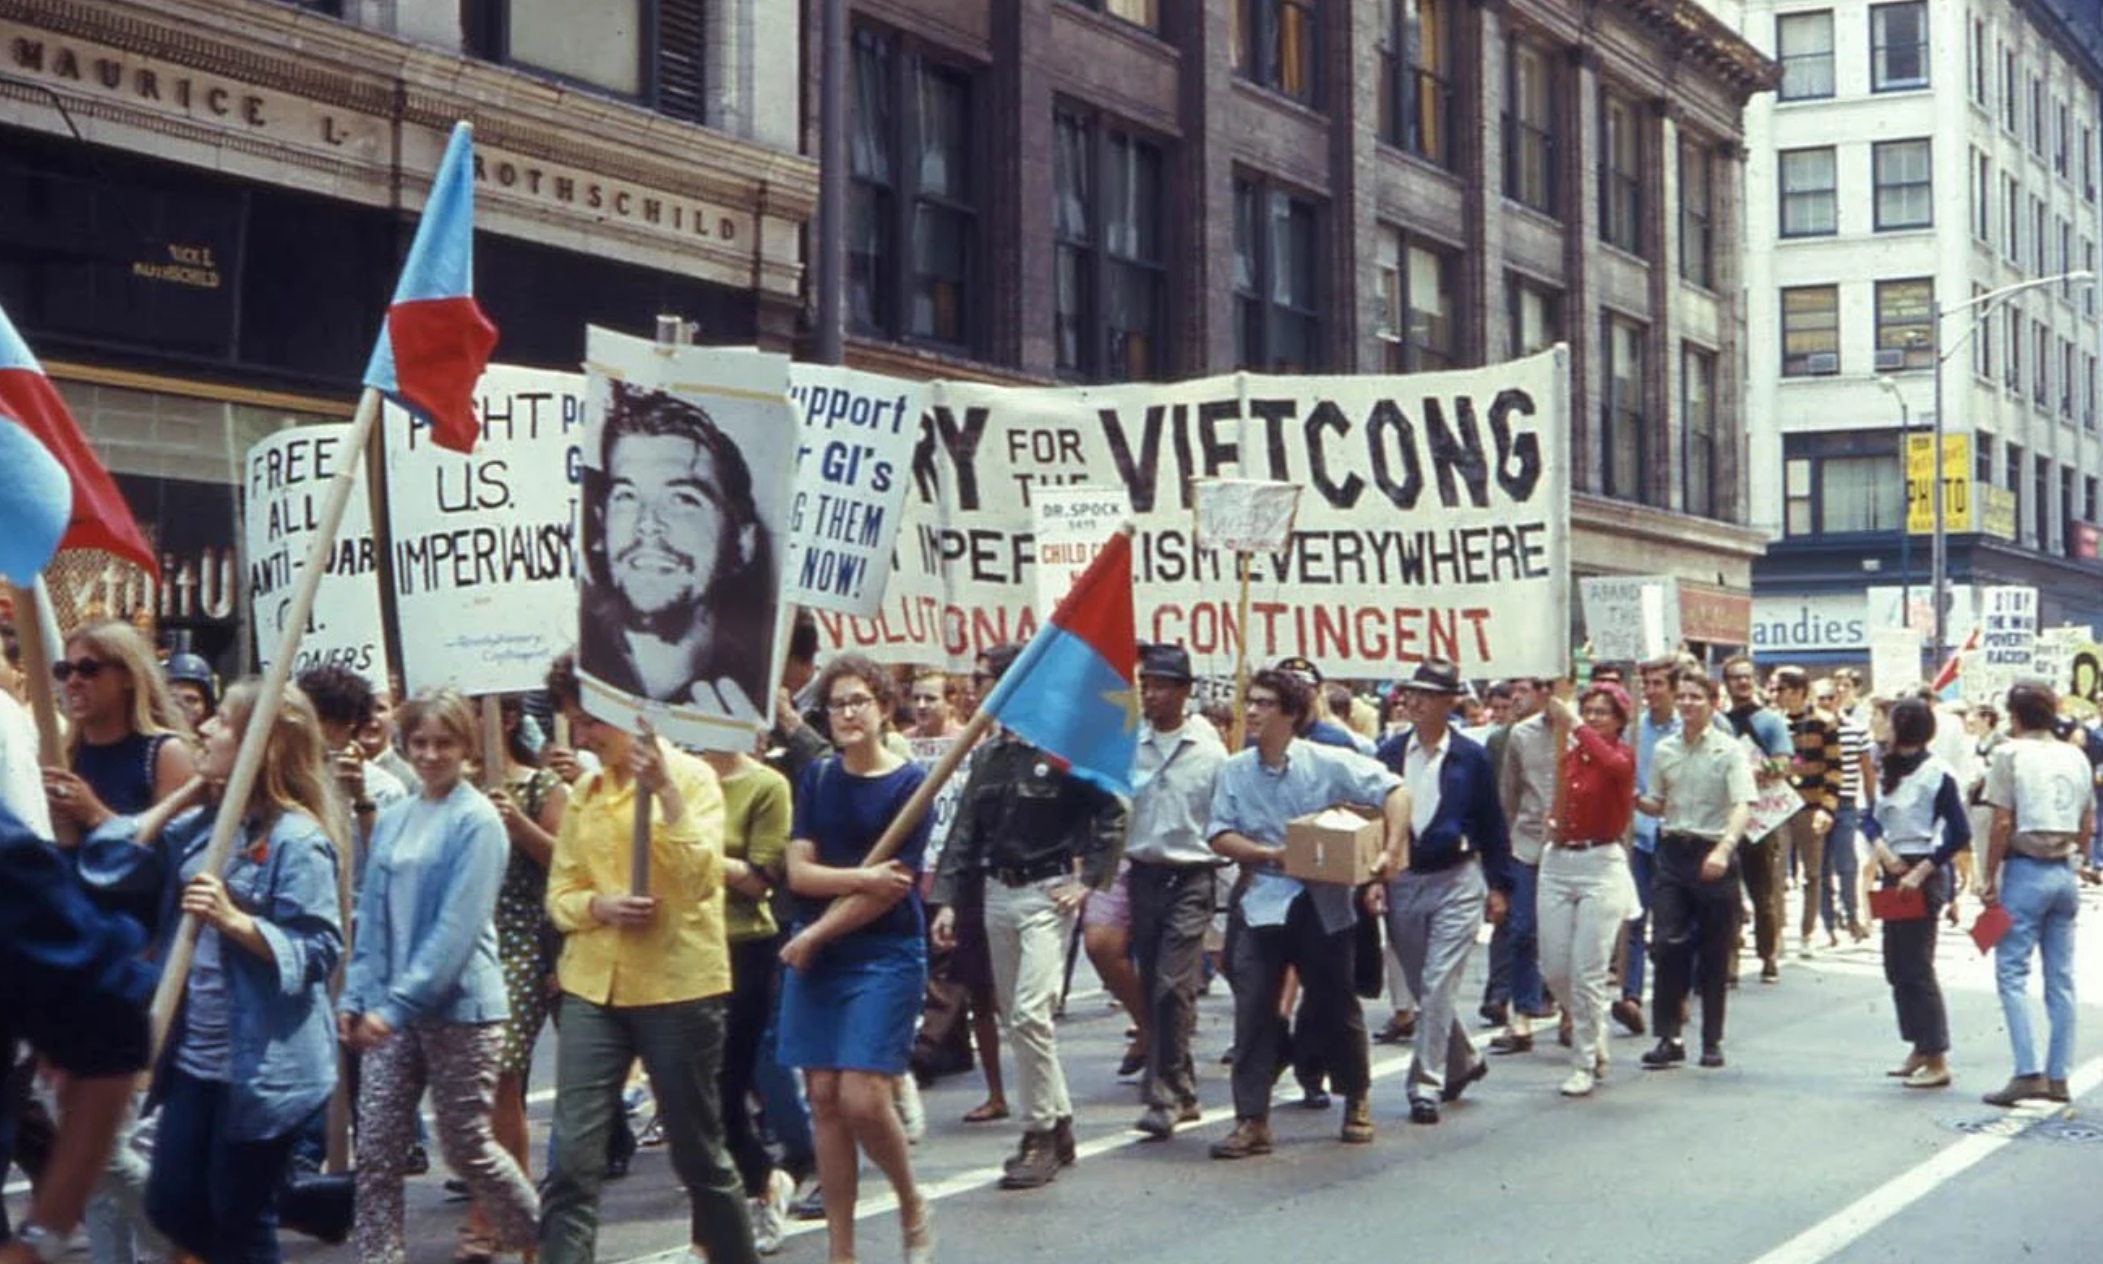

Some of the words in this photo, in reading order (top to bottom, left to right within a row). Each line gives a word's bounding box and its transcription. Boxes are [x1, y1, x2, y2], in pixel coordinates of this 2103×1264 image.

[10, 37, 266, 127] MAURICE
[474, 154, 735, 241] ROTHSCHILD
[252, 437, 340, 499] FREE
[821, 440, 893, 492] GI's
[1007, 428, 1086, 464] FOR
[1097, 388, 1542, 513] VIETCONG
[437, 459, 515, 514] U.S.
[268, 493, 318, 543] ALL
[815, 493, 885, 548] THEM
[799, 546, 867, 599] NOW!
[1236, 522, 1549, 585] EVERYWHERE
[1152, 601, 1493, 663] CONTINGENT
[1753, 606, 1864, 646] andies
